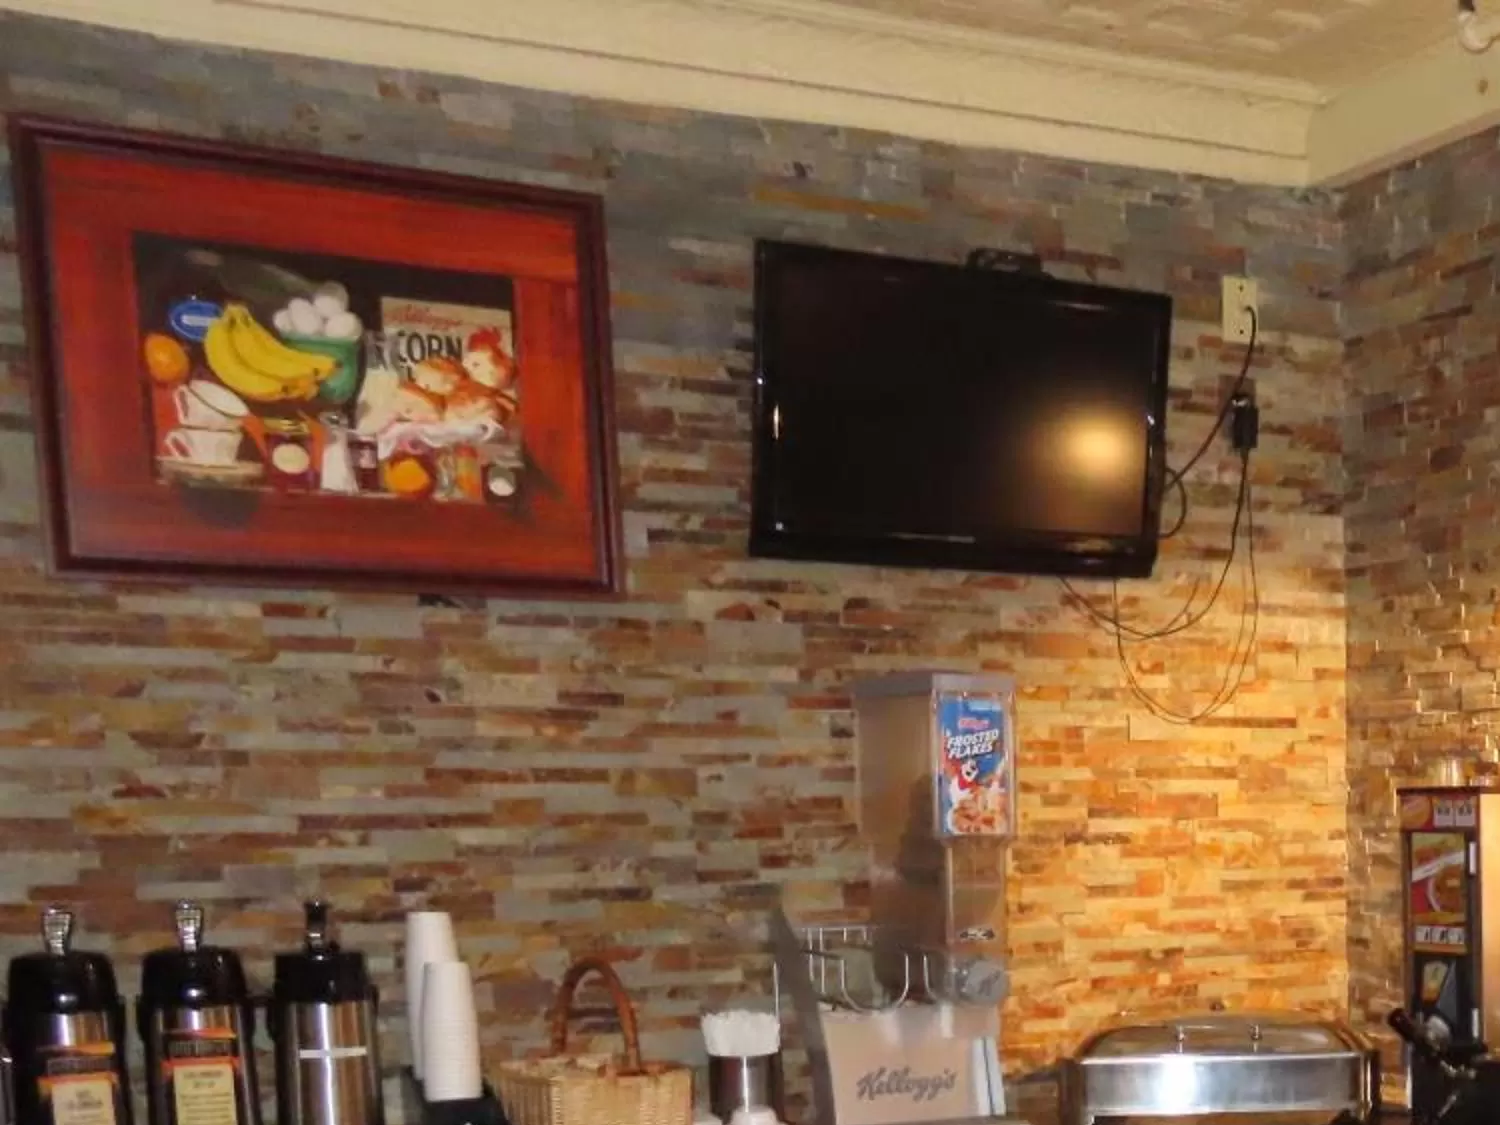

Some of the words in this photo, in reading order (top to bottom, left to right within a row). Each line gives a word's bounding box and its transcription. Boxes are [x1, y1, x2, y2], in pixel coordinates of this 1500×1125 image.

[948, 729, 999, 751] FROSTED
[948, 742, 993, 759] FLAKES
[856, 1066, 957, 1102] Kellogg's
